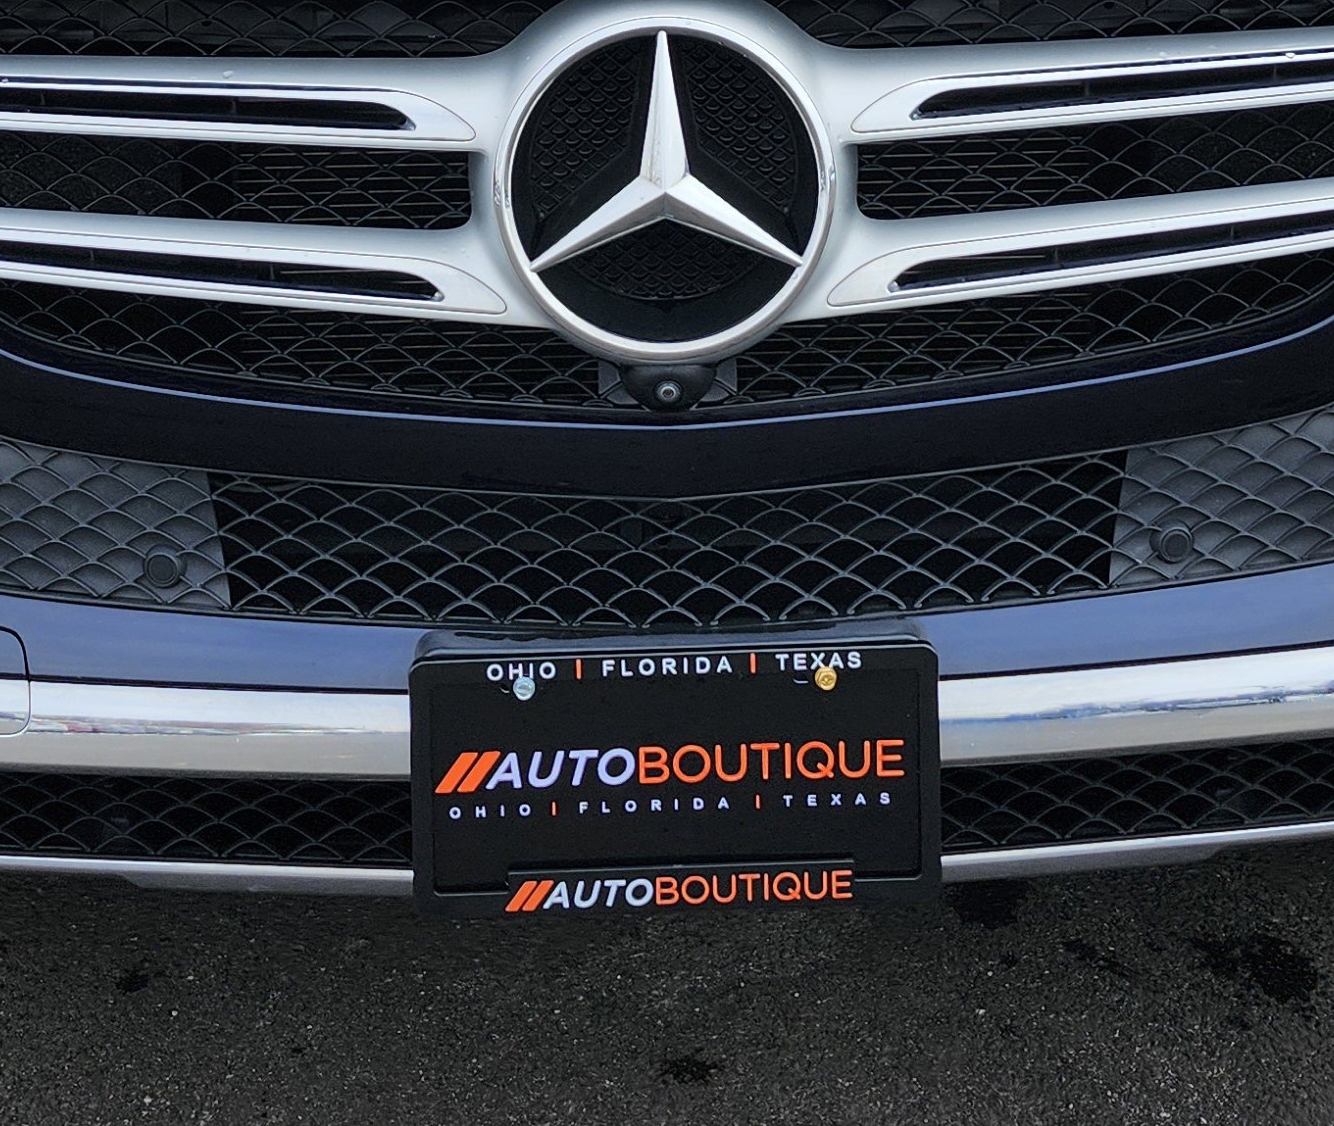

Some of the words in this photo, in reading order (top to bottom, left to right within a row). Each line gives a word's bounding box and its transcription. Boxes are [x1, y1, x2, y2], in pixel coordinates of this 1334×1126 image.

[486, 661, 557, 682] OHIO
[601, 655, 733, 677] FLORIDA
[774, 650, 863, 671] TEXAS
[485, 739, 905, 790] AUTOBOUTIQUE
[448, 804, 531, 820] OHIO
[579, 796, 730, 814] FLORIDA
[782, 792, 891, 808] TEXAS
[542, 869, 854, 910] AUTOBOUTIQUE
